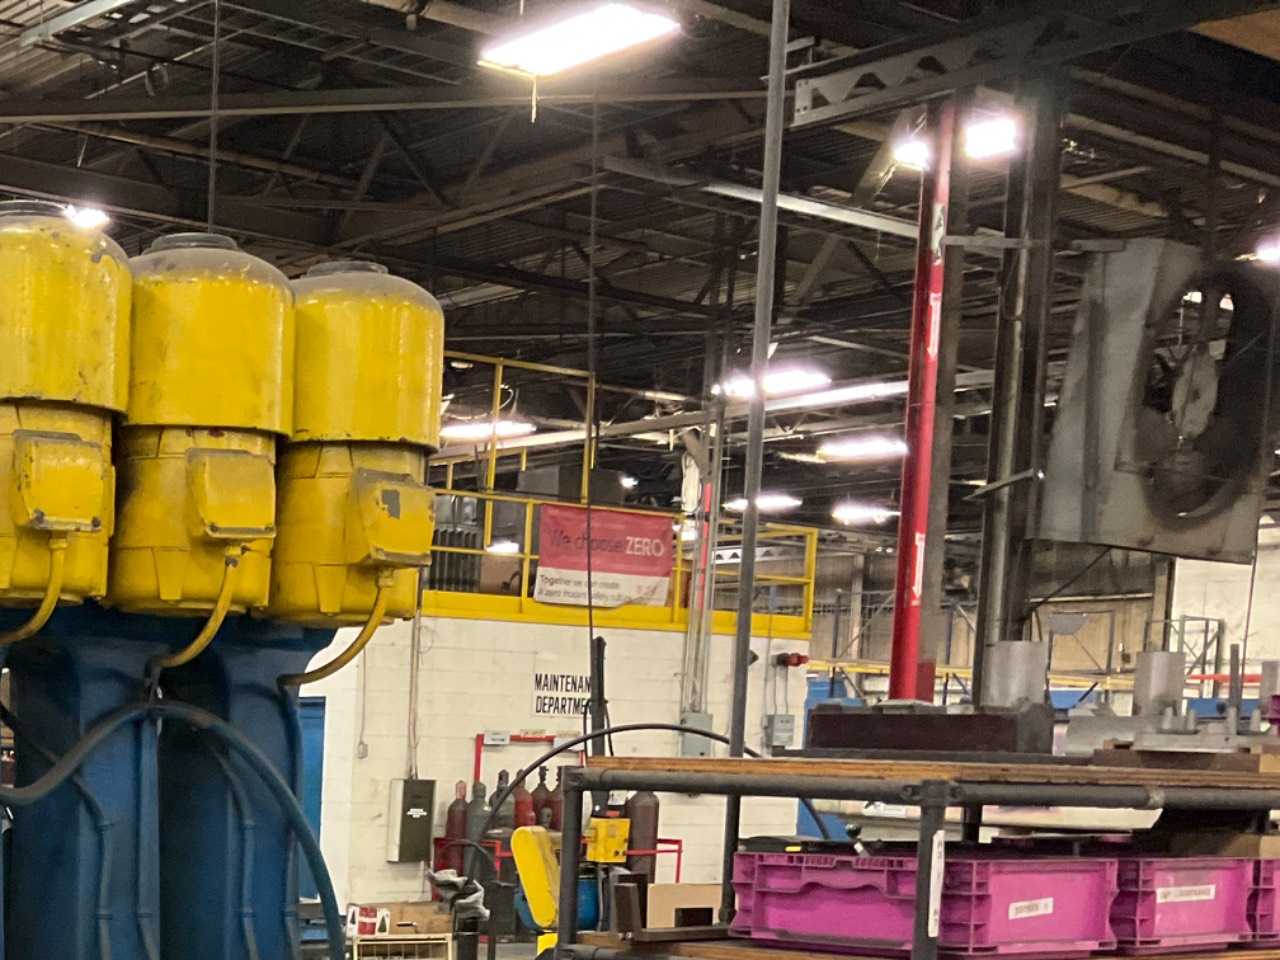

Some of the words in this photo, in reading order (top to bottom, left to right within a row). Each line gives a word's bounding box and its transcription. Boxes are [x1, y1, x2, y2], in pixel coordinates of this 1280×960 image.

[625, 536, 665, 556] ZERO
[534, 673, 592, 693] MAINTENAN
[535, 696, 587, 715] DEPARTME
